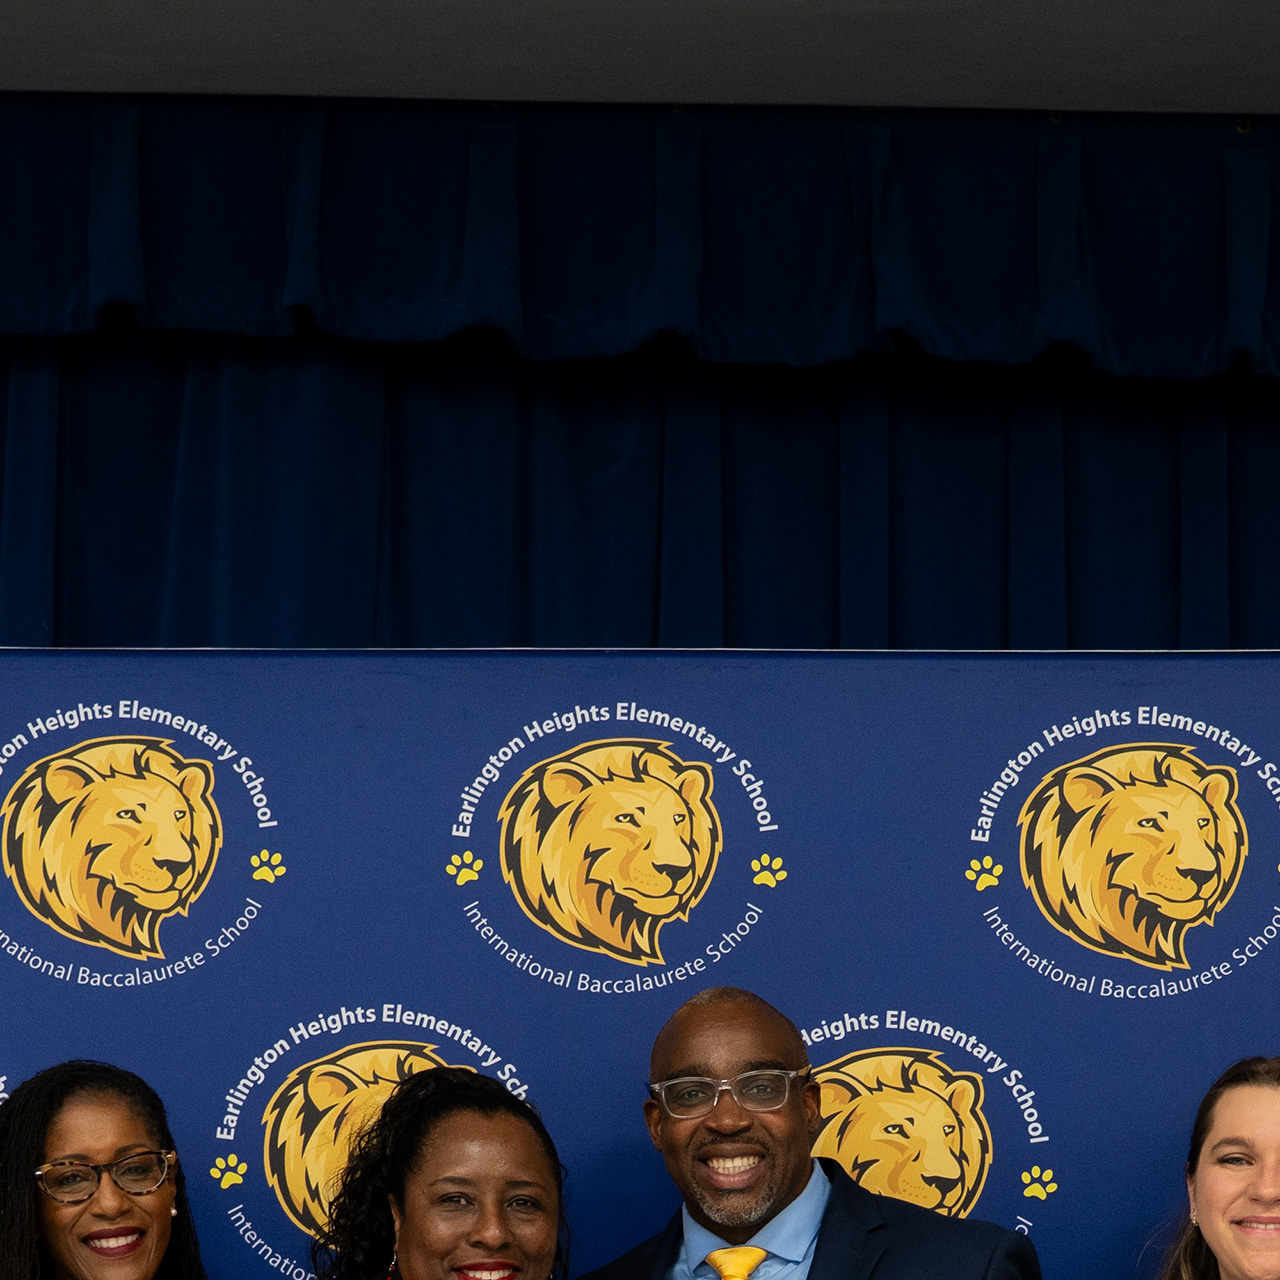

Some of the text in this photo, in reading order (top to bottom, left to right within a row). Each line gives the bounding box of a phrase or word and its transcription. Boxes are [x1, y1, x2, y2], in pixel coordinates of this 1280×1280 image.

[26, 703, 113, 739] Heights
[118, 700, 238, 761] Elementary
[232, 756, 278, 828] School
[451, 702, 779, 838] Earlington Heights Elementary School
[970, 741, 1045, 843] Earlington
[1042, 709, 1132, 747] Heights
[1137, 706, 1262, 767] Elementary
[77, 952, 206, 987] Baccalaurete
[205, 897, 262, 957] School
[463, 900, 763, 994] International Baccalaurete School
[983, 906, 1096, 994] International
[1100, 962, 1233, 999] Baccalaurete
[216, 1003, 528, 1141] Earlington Heights Elementary Sch
[885, 1010, 1009, 1074] Elementary
[1002, 1069, 1050, 1144] School
